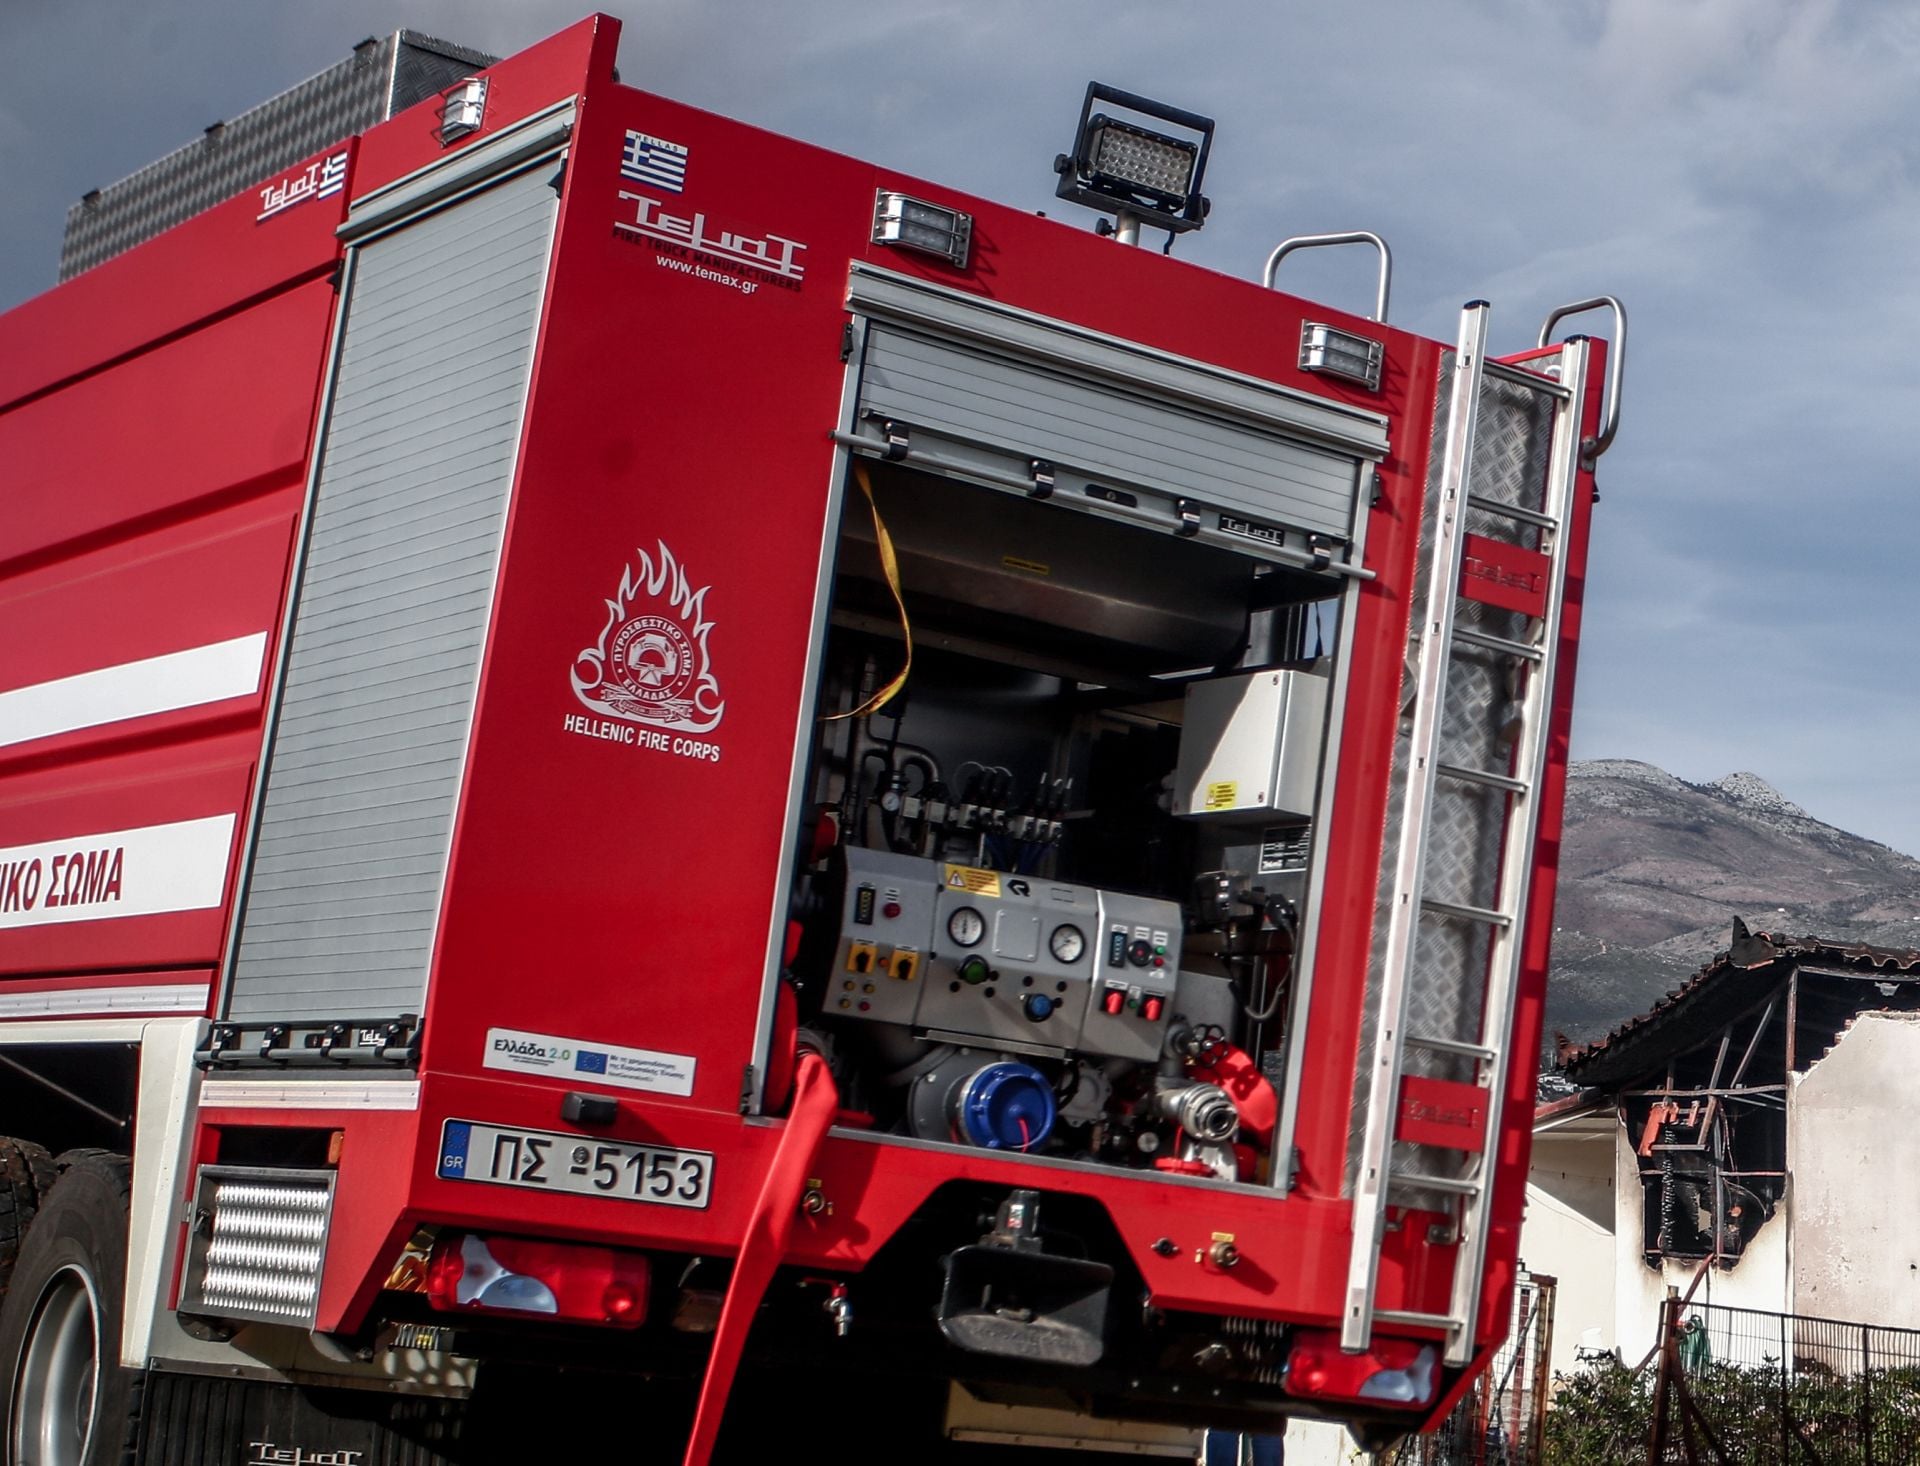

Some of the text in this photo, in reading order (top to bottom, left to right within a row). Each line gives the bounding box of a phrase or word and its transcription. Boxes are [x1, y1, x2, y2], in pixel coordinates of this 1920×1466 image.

[635, 133, 678, 153] HELLAS
[612, 228, 802, 292] FIRE TRUCK MANUFACTURERS
[656, 255, 758, 293] www.temax.gr
[614, 618, 692, 676] ΠΥΡΟΣΒΕΣΤΙΚΟ ΣΩΜΑ
[623, 679, 673, 700] ΕΛΛΑΔΑΣ
[563, 714, 720, 762] HELLENIC FIRE CORPS
[0, 847, 124, 913] ΙΚΟ ΣΩΜΑ
[494, 1039, 571, 1060] Ελλάδα 2.0
[444, 1154, 464, 1169] GR
[491, 1133, 552, 1183] ΠΣ
